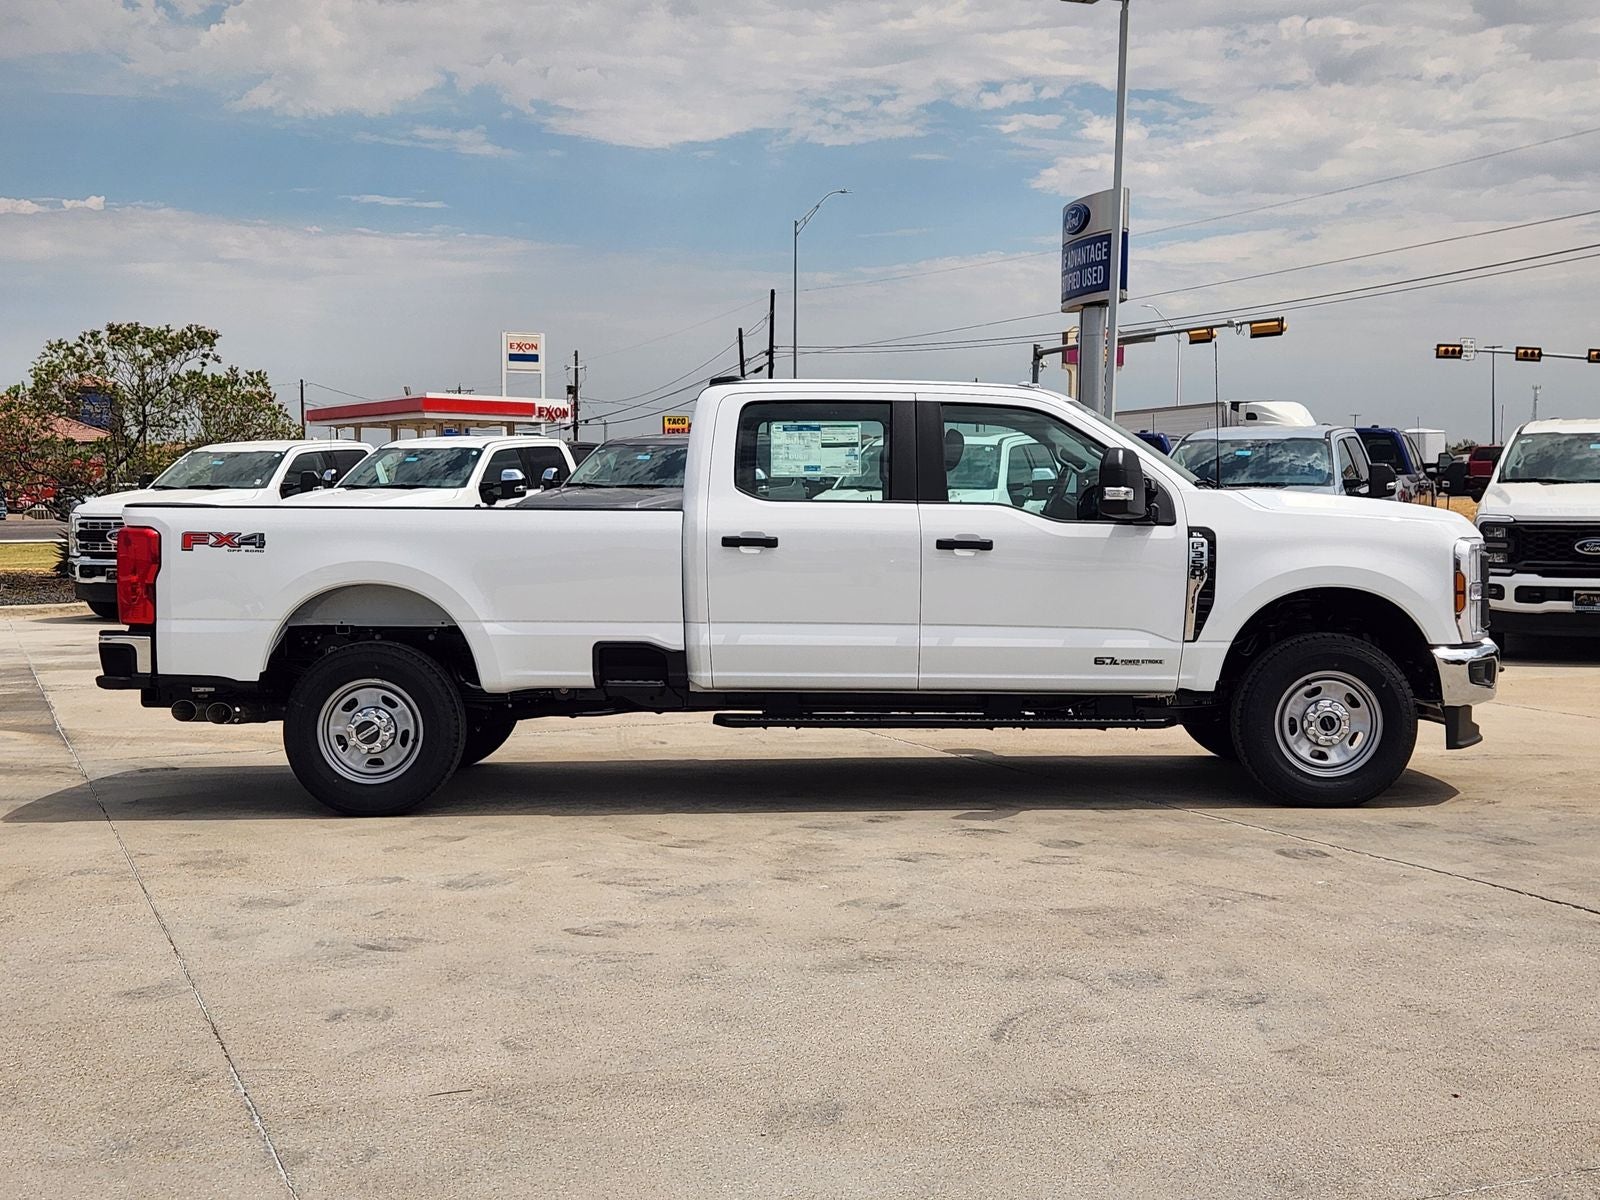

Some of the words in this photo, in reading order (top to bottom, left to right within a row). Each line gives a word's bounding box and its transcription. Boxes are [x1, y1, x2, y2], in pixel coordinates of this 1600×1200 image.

[1065, 209, 1080, 229] Ford
[1068, 241, 1108, 269] ADVANTAGE
[1081, 265, 1104, 288] USED
[509, 342, 538, 352] EXXON
[537, 405, 569, 421] EXXON
[181, 531, 266, 551] FX4
[1094, 657, 1120, 666] 6.7L
